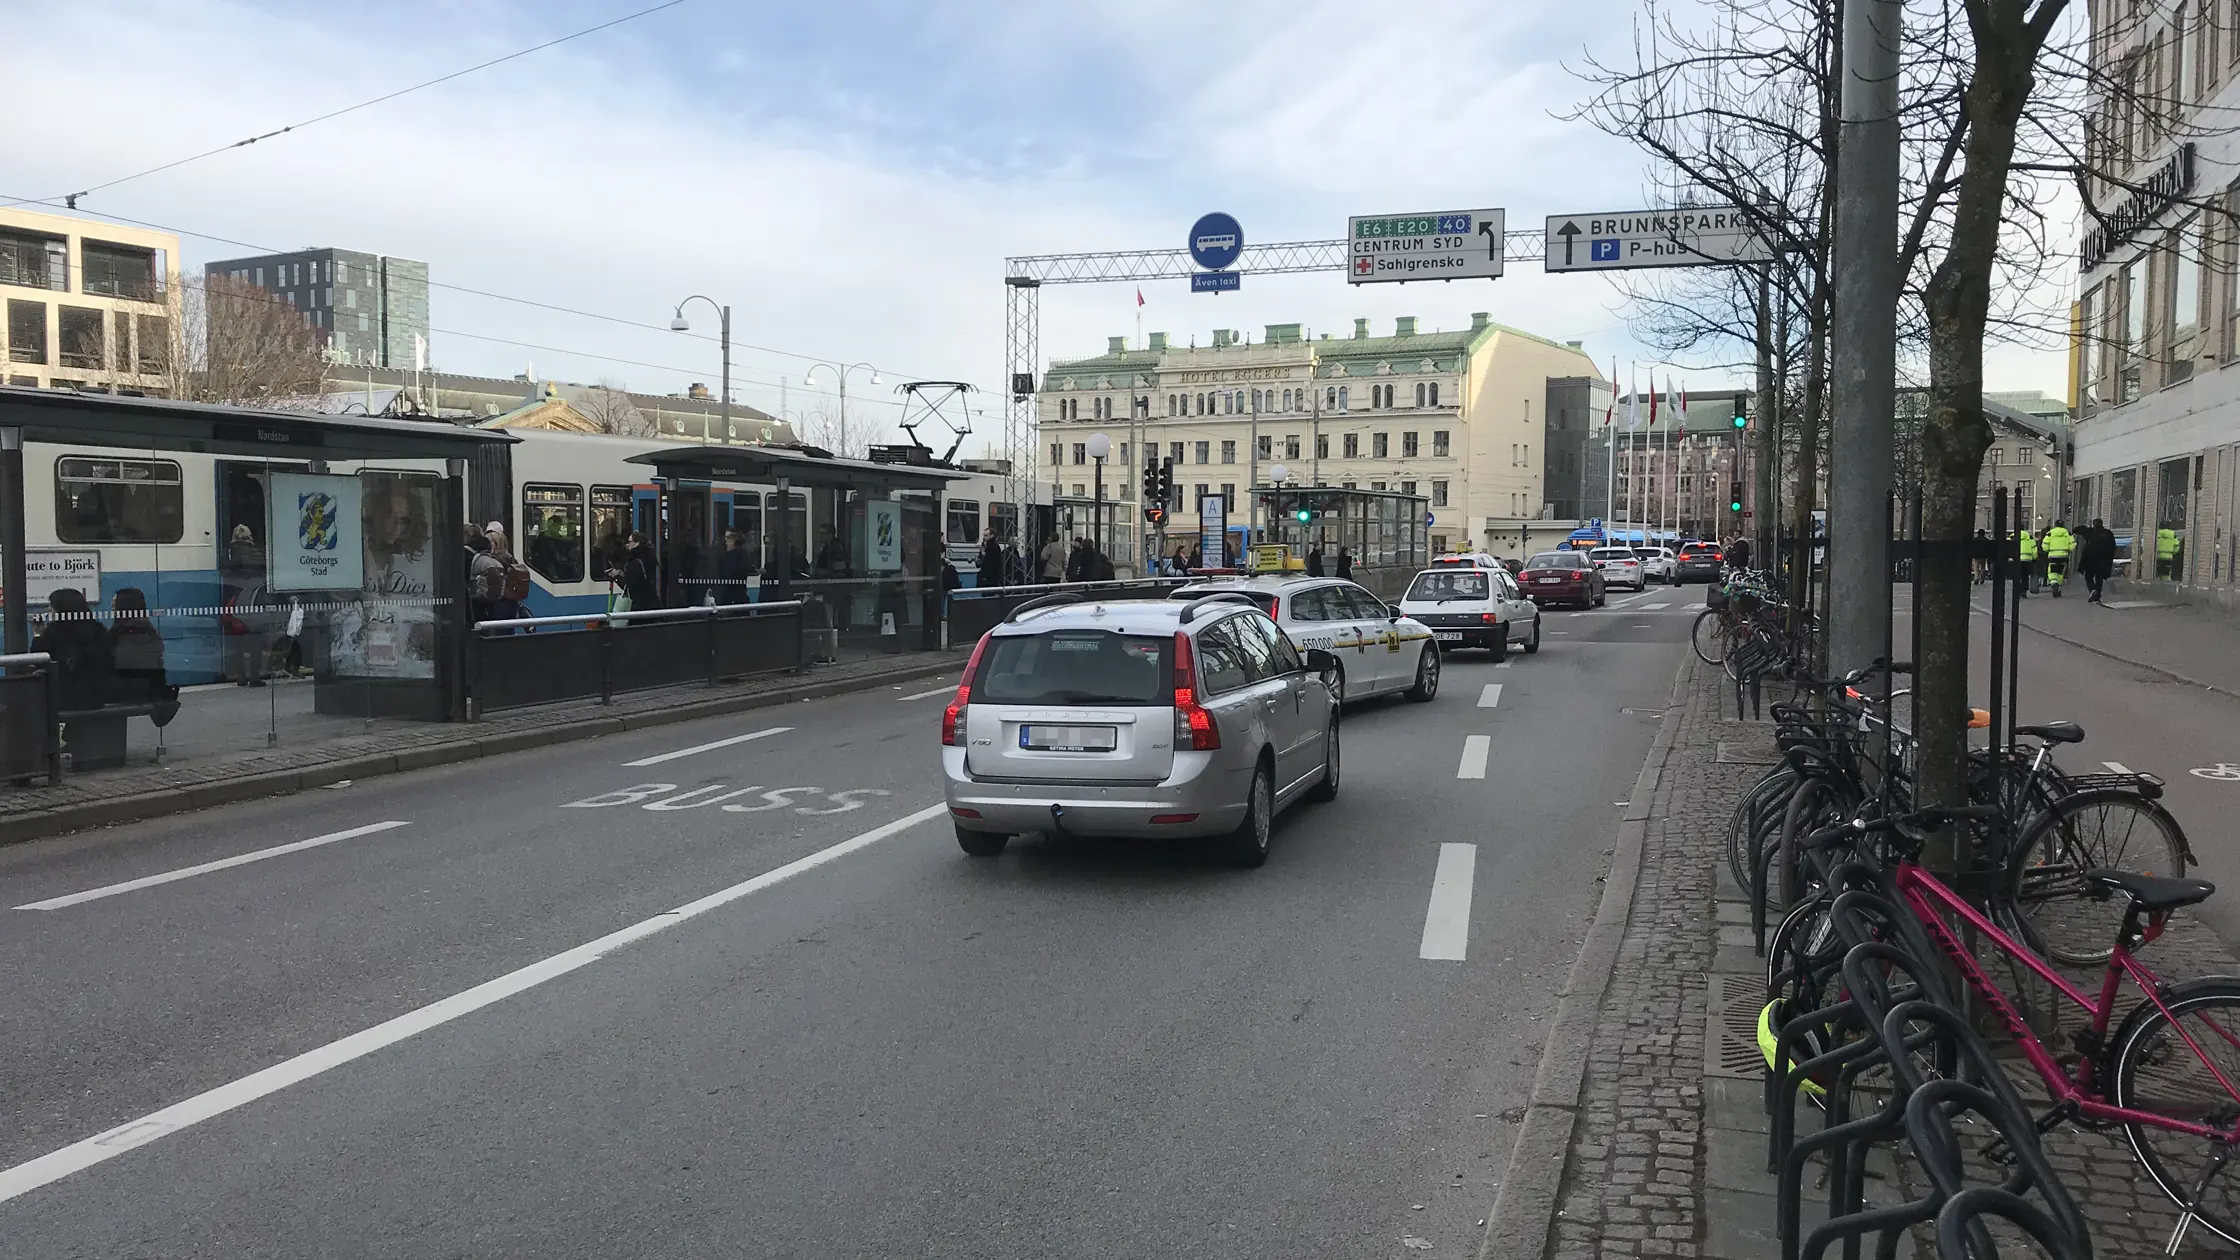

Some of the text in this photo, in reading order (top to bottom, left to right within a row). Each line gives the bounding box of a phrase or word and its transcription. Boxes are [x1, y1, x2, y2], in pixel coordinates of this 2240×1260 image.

[1363, 218, 1465, 235] E6 E20 40
[1591, 212, 1771, 235] BRUNNSPARK
[1354, 236, 1463, 253] CENTRUM SYD
[1630, 240, 1688, 257] P-hus
[1377, 256, 1464, 272] Sahlgrenska
[1195, 276, 1237, 287] Även taxi
[1180, 367, 1291, 383] HOTEL EGGERS
[257, 429, 290, 441] Nordstan
[1208, 499, 1217, 514] A
[27, 558, 95, 573] ute to Björk
[300, 555, 338, 567] Göteborgs
[311, 567, 327, 576] Stad
[387, 571, 426, 595] Dior
[1446, 632, 1460, 640] 728
[1302, 637, 1334, 652] 650 000
[558, 783, 891, 815] BUSS
